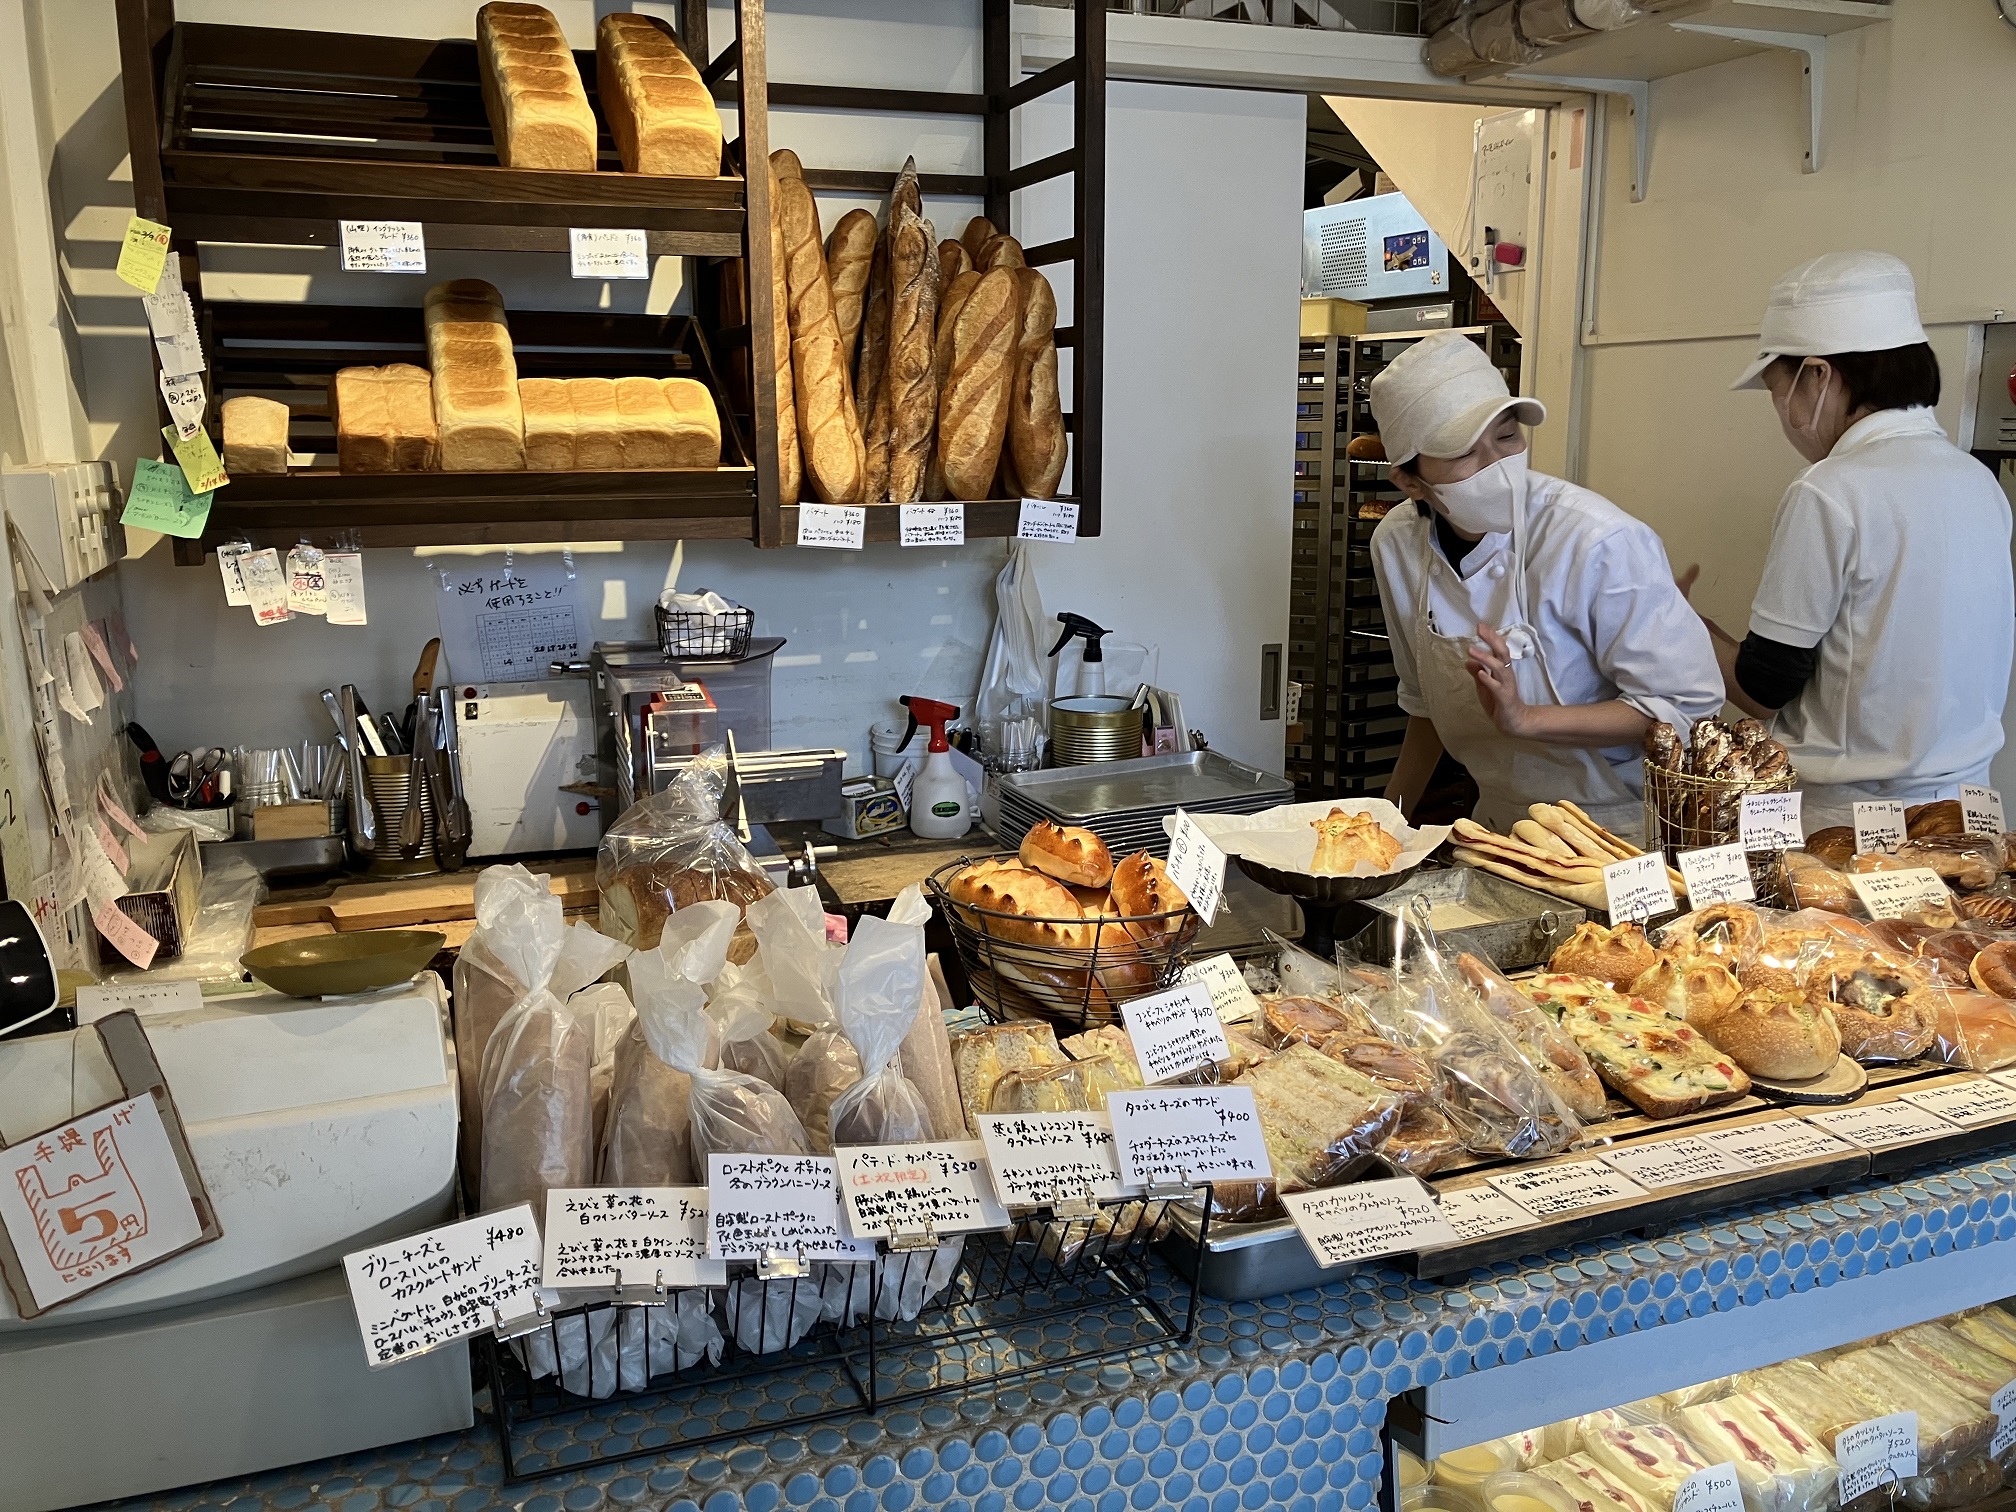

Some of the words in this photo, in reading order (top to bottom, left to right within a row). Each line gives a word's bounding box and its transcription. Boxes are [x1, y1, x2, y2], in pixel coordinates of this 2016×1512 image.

[1190, 1007, 1213, 1023] ¥450
[1215, 1109, 1250, 1126] ¥400
[940, 1162, 977, 1178] ¥520
[1466, 1192, 1499, 1203] ¥300
[580, 1208, 669, 1225] 白ワインバターソース
[679, 1200, 710, 1221] ¥52
[1395, 1204, 1430, 1219] ¥520
[486, 1226, 524, 1251] ¥480
[62, 1246, 131, 1283] になります
[362, 1236, 445, 1277] ブリーチーズと
[379, 1256, 450, 1289] ロースハムの
[391, 1255, 483, 1300] カスクルートサンド
[1887, 1438, 1911, 1454] ¥520
[1705, 1479, 1732, 1495] ¥500
